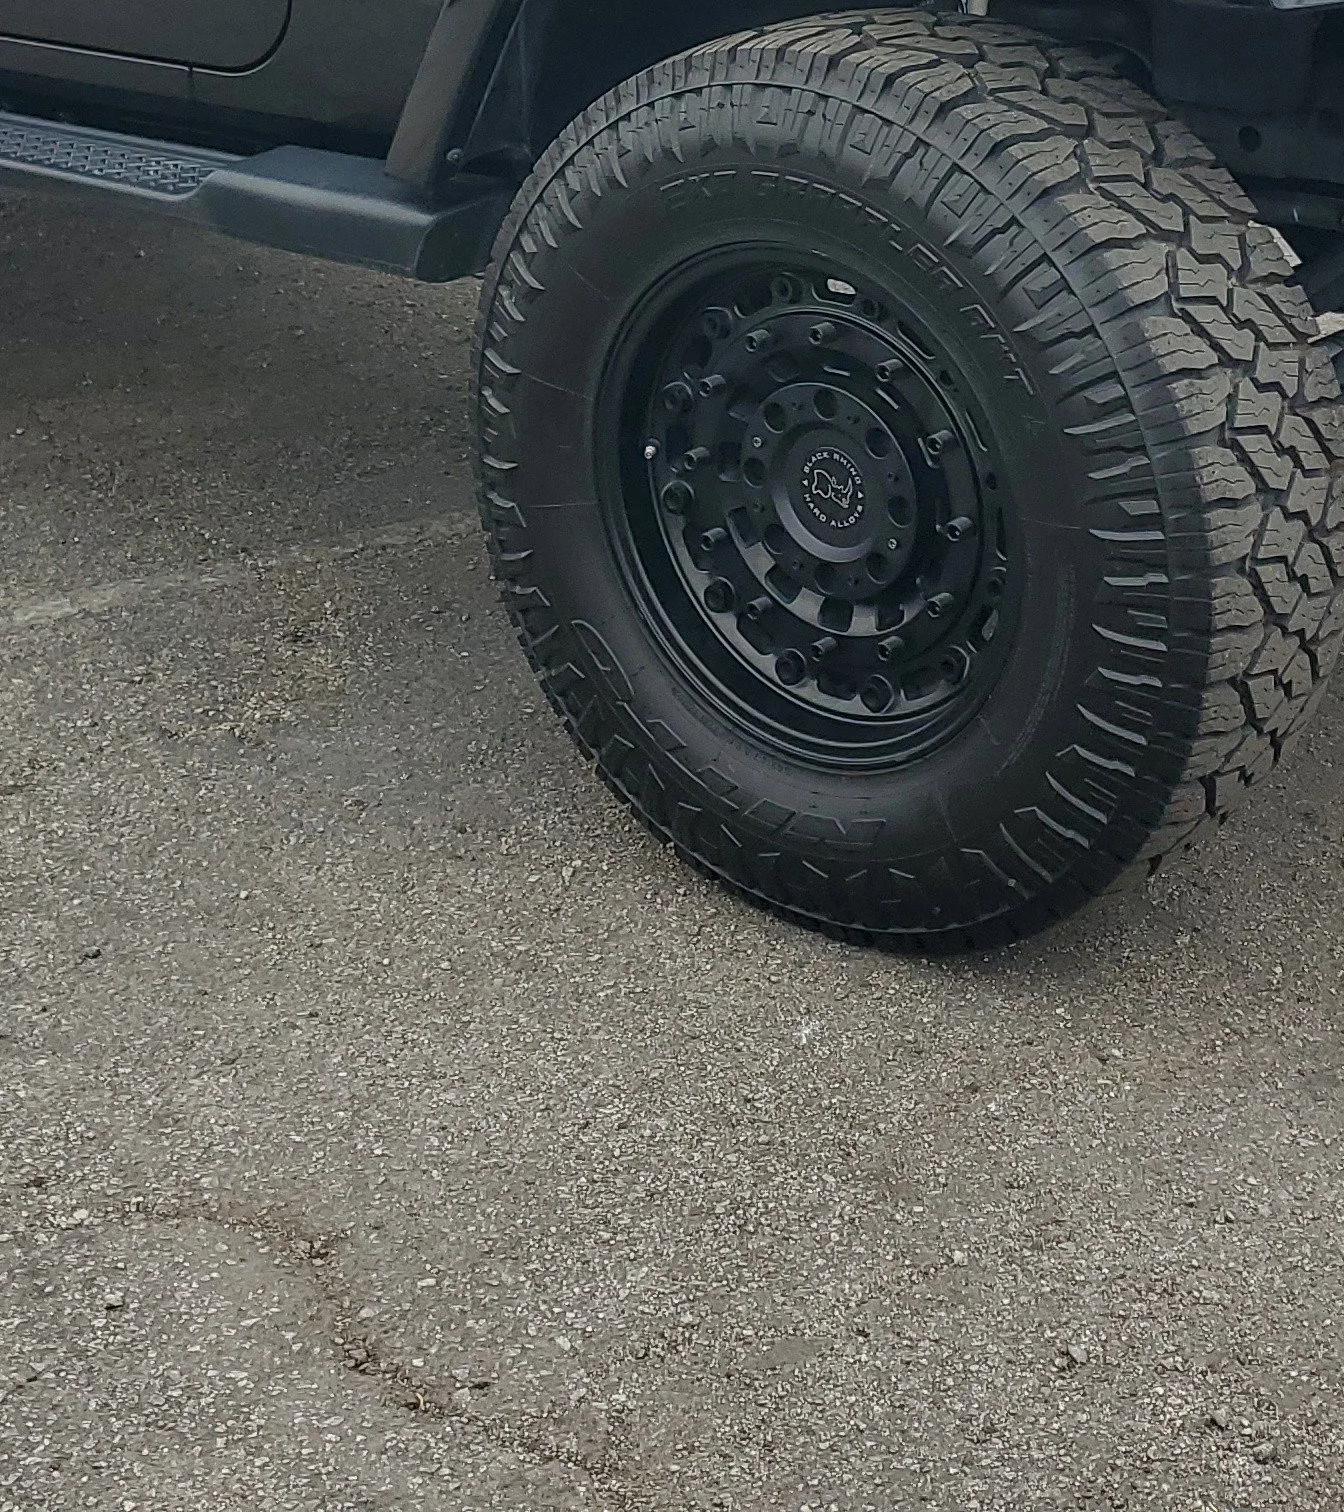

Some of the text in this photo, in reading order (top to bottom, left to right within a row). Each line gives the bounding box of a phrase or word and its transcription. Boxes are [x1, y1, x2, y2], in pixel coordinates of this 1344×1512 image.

[803, 451, 862, 484] BLACK RHINO
[804, 493, 863, 528] HARD ALLOYS
